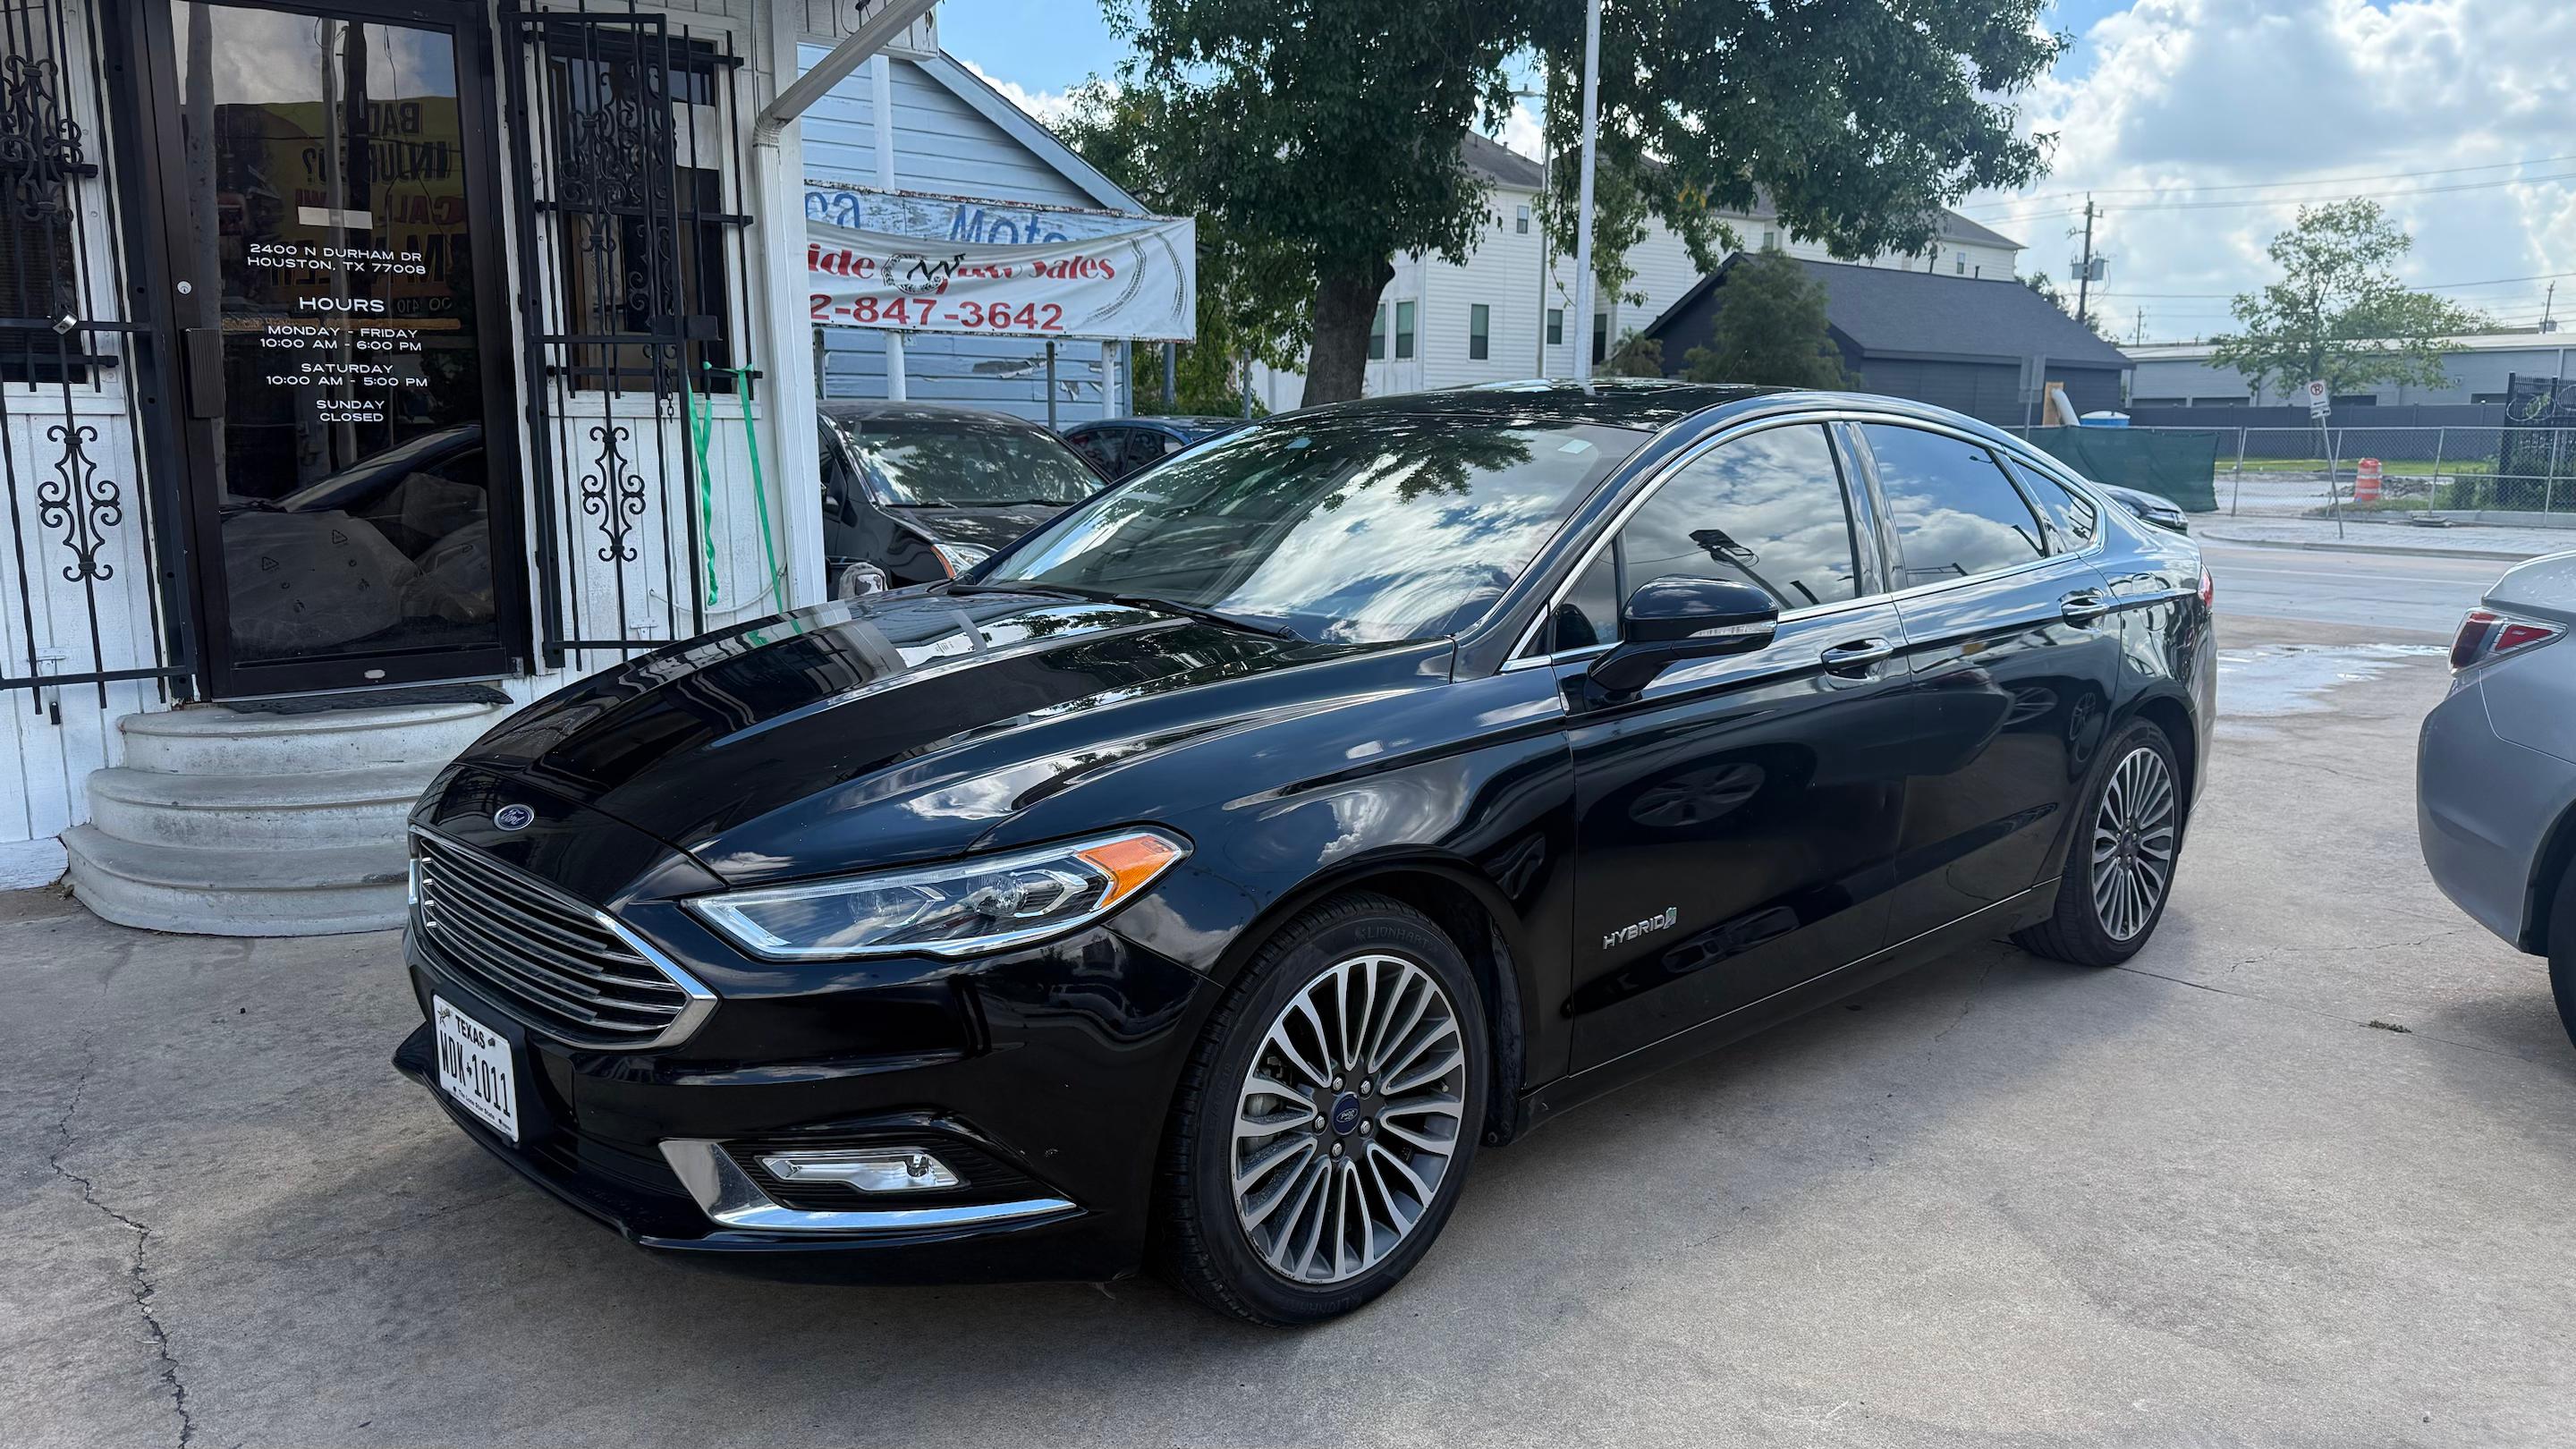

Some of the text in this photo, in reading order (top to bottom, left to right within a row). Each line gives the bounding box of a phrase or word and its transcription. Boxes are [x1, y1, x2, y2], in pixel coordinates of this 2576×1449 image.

[805, 191, 861, 229] ca
[250, 243, 422, 262] 2400 N DURHAM DR
[808, 243, 875, 279] ide
[247, 256, 427, 275] HOUSTON, TX 77008
[299, 296, 385, 313] HOURS
[810, 293, 1064, 331] 2-847-3642
[267, 325, 341, 336] MONDAY
[360, 327, 418, 339] FRIDAY
[259, 338, 305, 349] 10:00
[312, 339, 338, 350] AM
[356, 340, 393, 351] 6:00
[399, 341, 422, 352] PM
[301, 362, 394, 374] SATURDAY
[266, 375, 310, 386] 10:00
[318, 376, 343, 386] AM
[363, 377, 399, 386] 5:00
[405, 377, 428, 387] PM
[316, 399, 385, 410] SUNDAY
[319, 412, 384, 422] CLOSED
[1602, 913, 1665, 950] HYBRID
[454, 1014, 486, 1050] TEXAS
[471, 1053, 511, 1118] 1011
